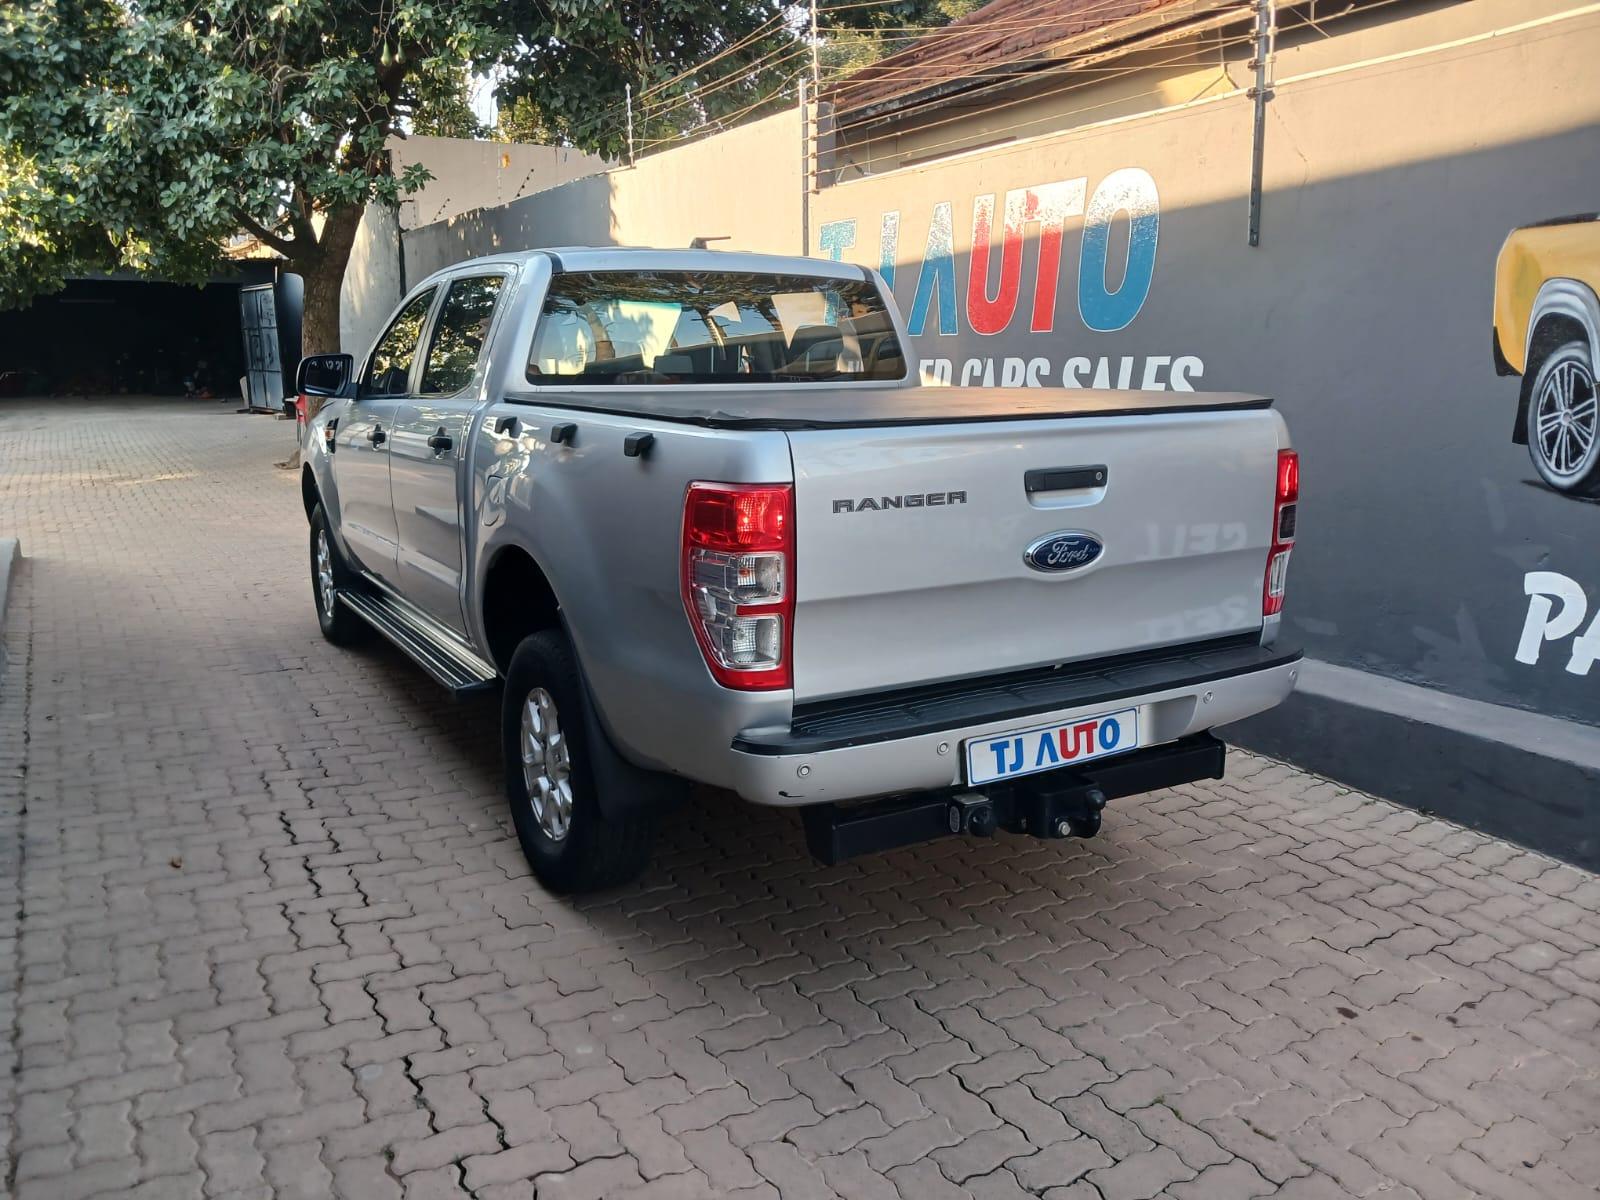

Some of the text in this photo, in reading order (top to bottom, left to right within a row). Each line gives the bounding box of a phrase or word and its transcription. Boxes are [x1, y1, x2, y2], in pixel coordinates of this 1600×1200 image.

[907, 167, 1160, 336] AUTO
[832, 490, 967, 513] RANGER
[1047, 540, 1089, 565] Ford
[990, 718, 1120, 774] TJ AUTO
